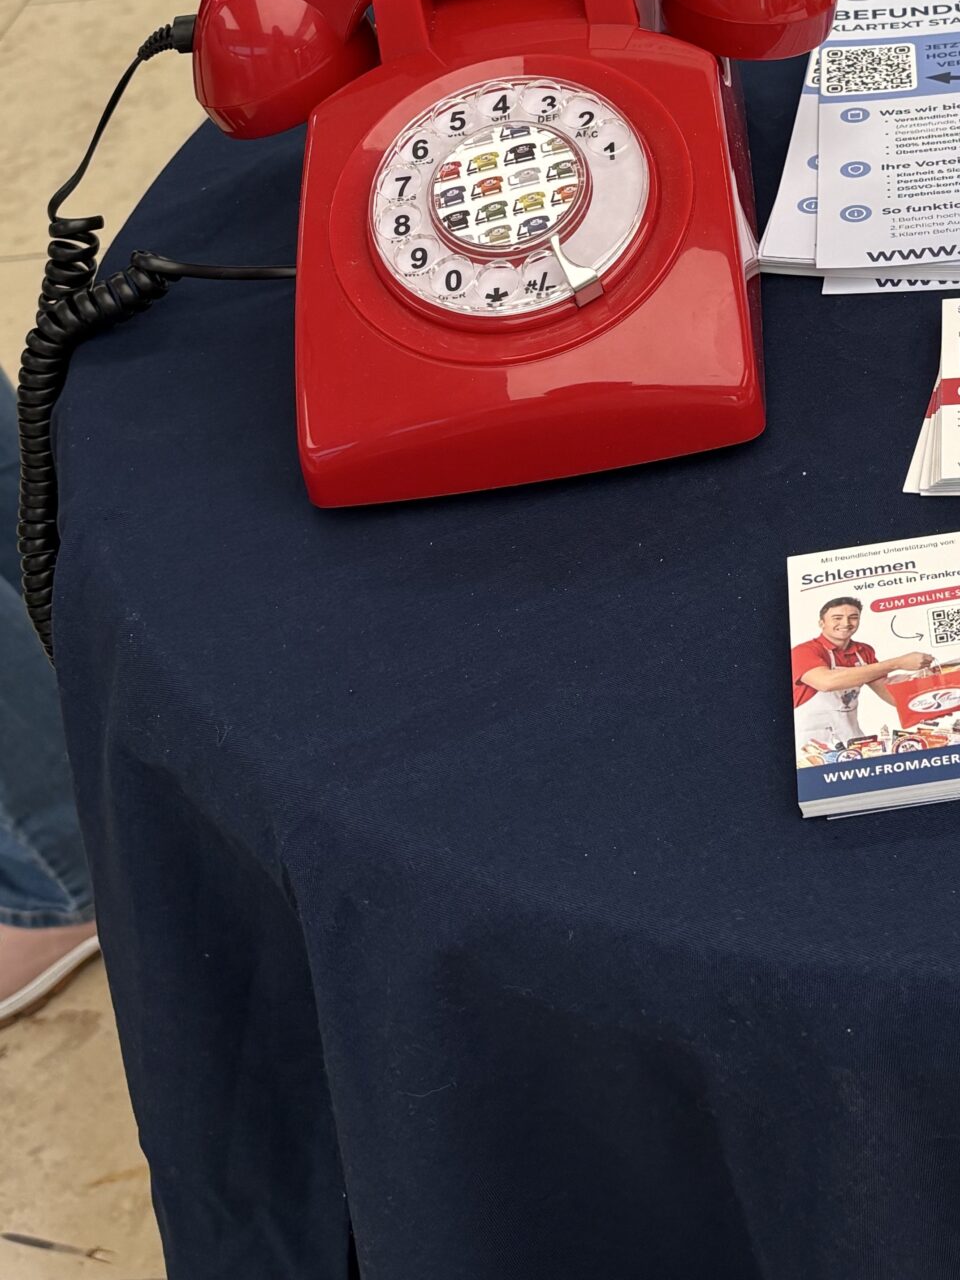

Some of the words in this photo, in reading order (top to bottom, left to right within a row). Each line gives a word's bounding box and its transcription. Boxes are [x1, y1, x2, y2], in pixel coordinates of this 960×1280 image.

[879, 108, 911, 116] Was
[915, 105, 939, 113] wir
[881, 162, 912, 171] Ihre
[882, 207, 902, 215] So
[801, 559, 917, 586] Schlemmen
[854, 582, 875, 591] wie
[877, 577, 903, 588] Gott
[906, 575, 917, 583] in
[879, 599, 905, 610] ZUM
